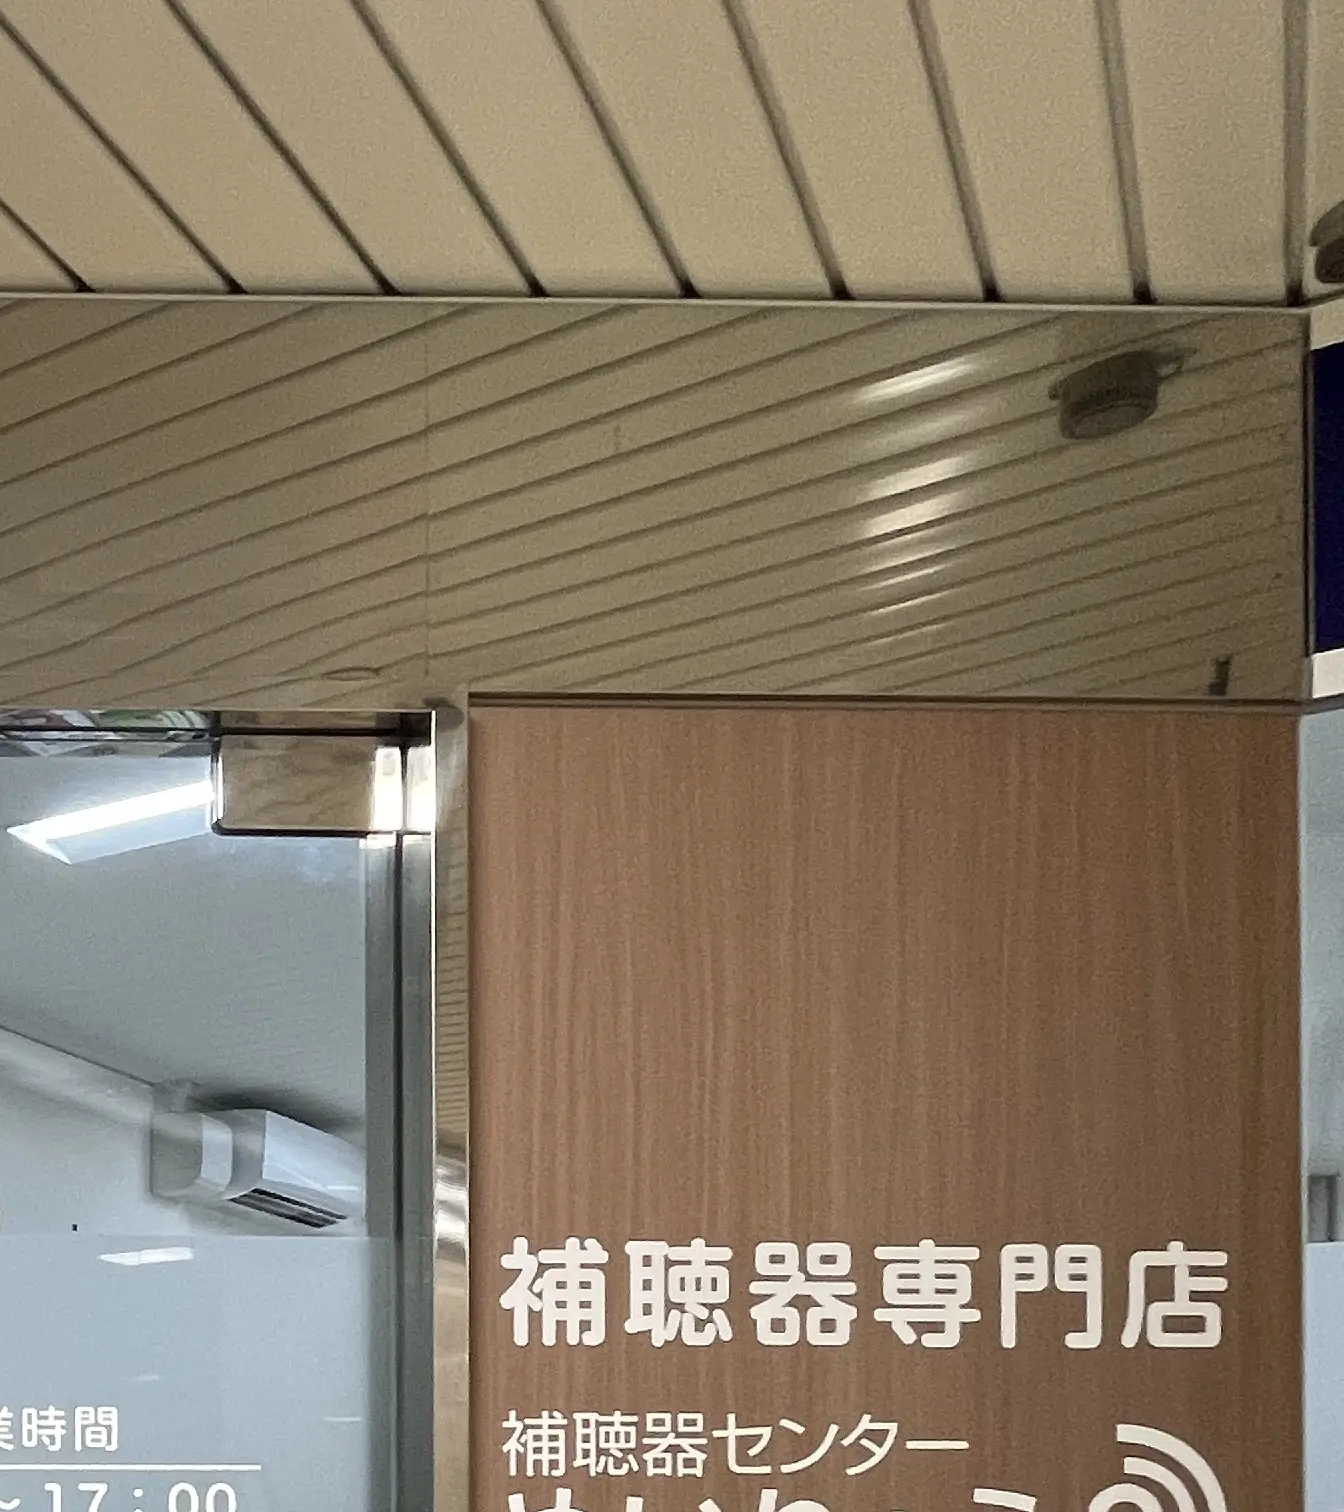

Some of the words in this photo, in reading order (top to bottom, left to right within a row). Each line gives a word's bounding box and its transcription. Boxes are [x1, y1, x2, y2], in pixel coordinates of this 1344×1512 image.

[498, 1236, 1230, 1349] 補聴器専門店
[500, 1409, 970, 1478] 補聴器センター
